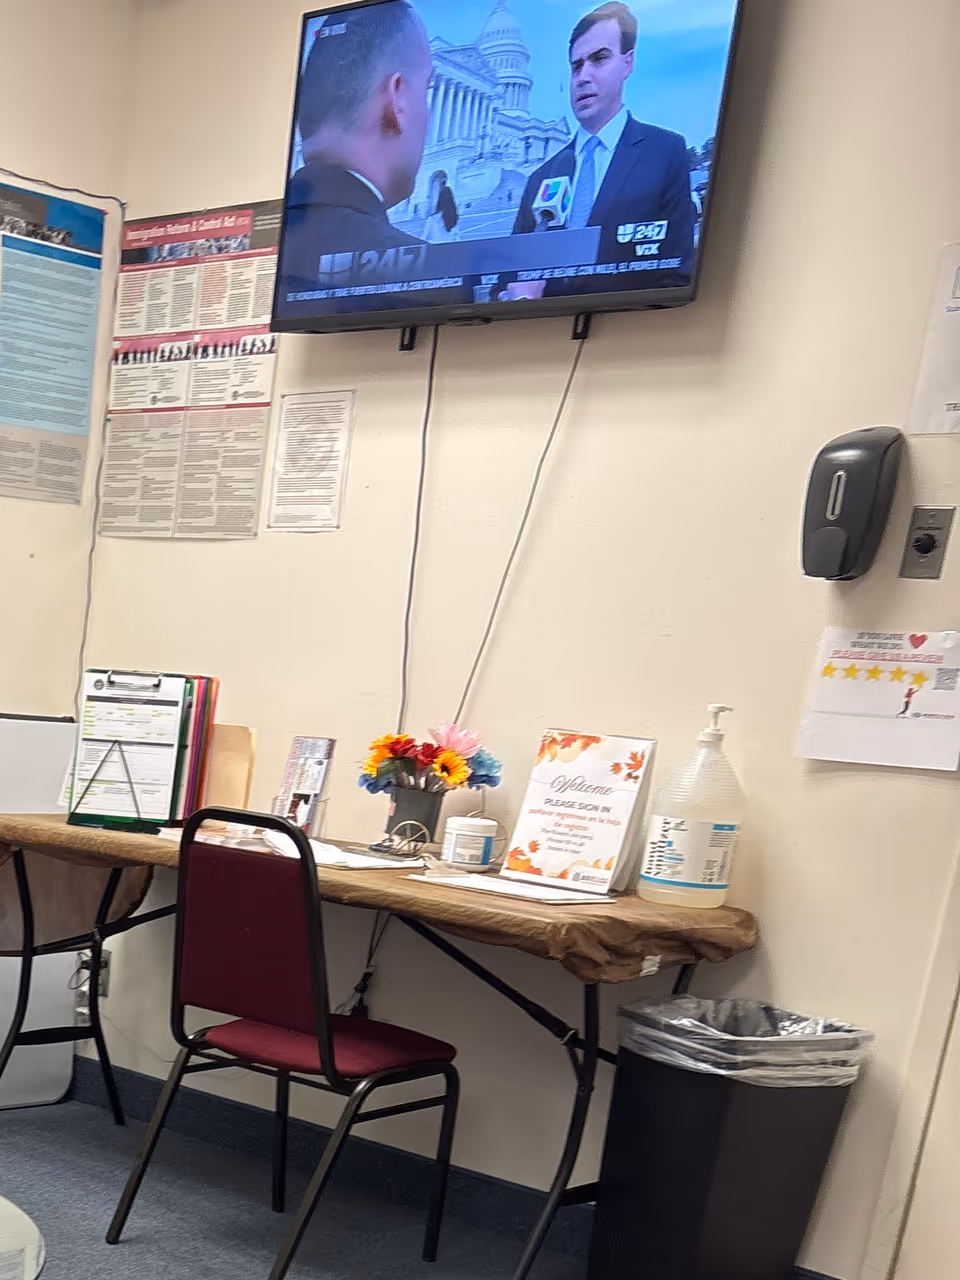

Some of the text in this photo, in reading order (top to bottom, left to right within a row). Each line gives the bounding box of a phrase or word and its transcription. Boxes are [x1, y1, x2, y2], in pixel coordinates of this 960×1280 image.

[126, 226, 166, 242] Immigration
[198, 217, 223, 231] Control
[550, 775, 614, 796] Welcome
[544, 798, 612, 814] PLEASE SIGN IN
